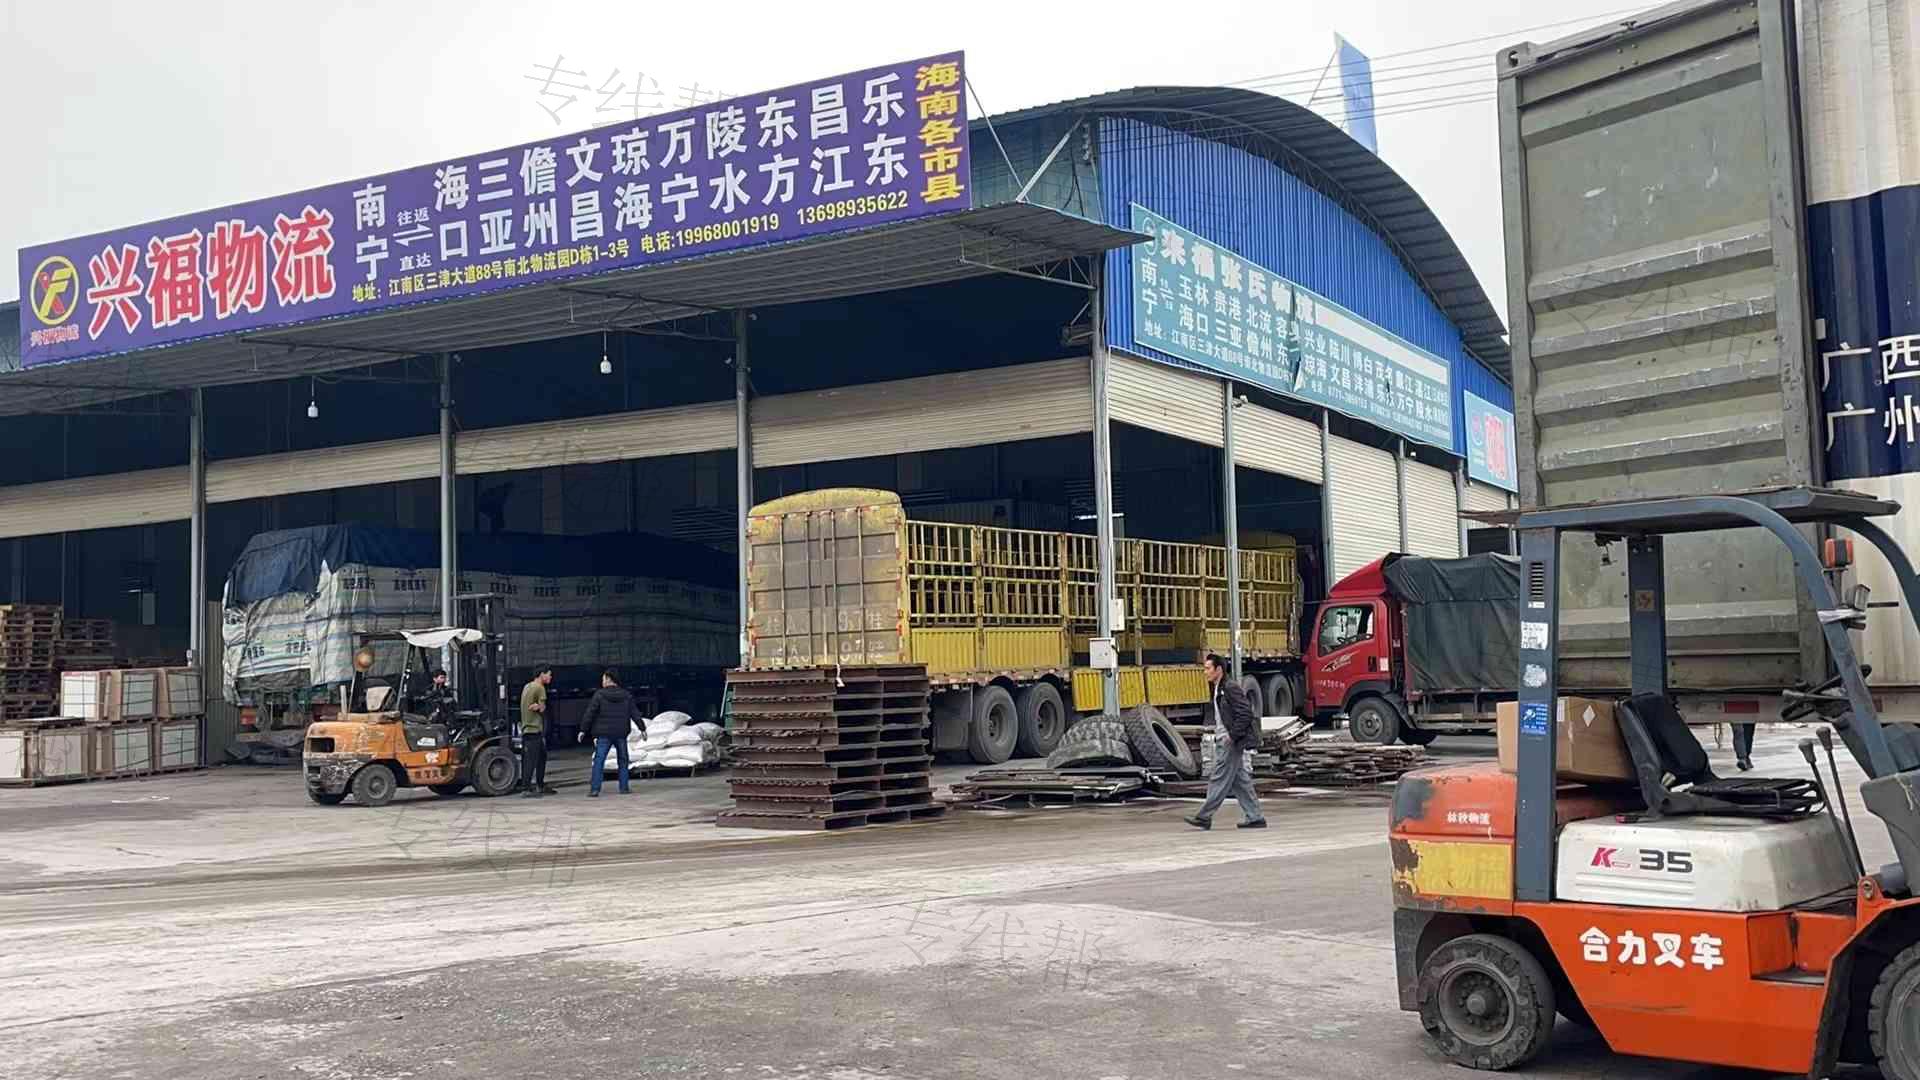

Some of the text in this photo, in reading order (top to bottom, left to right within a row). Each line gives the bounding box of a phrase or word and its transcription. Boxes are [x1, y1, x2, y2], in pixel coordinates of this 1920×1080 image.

[915, 61, 965, 204] 海南各市县
[353, 182, 390, 282] 南宁
[396, 206, 430, 227] 往返
[796, 190, 908, 226] 13698935622
[86, 205, 338, 340] 兴福物流
[399, 252, 433, 273] 直达
[1141, 256, 1158, 315] 南宁
[1822, 334, 1920, 392] 广西
[1826, 395, 1920, 452] 广州
[1639, 849, 1693, 873] 35
[1579, 926, 1725, 970] 合力叉车
